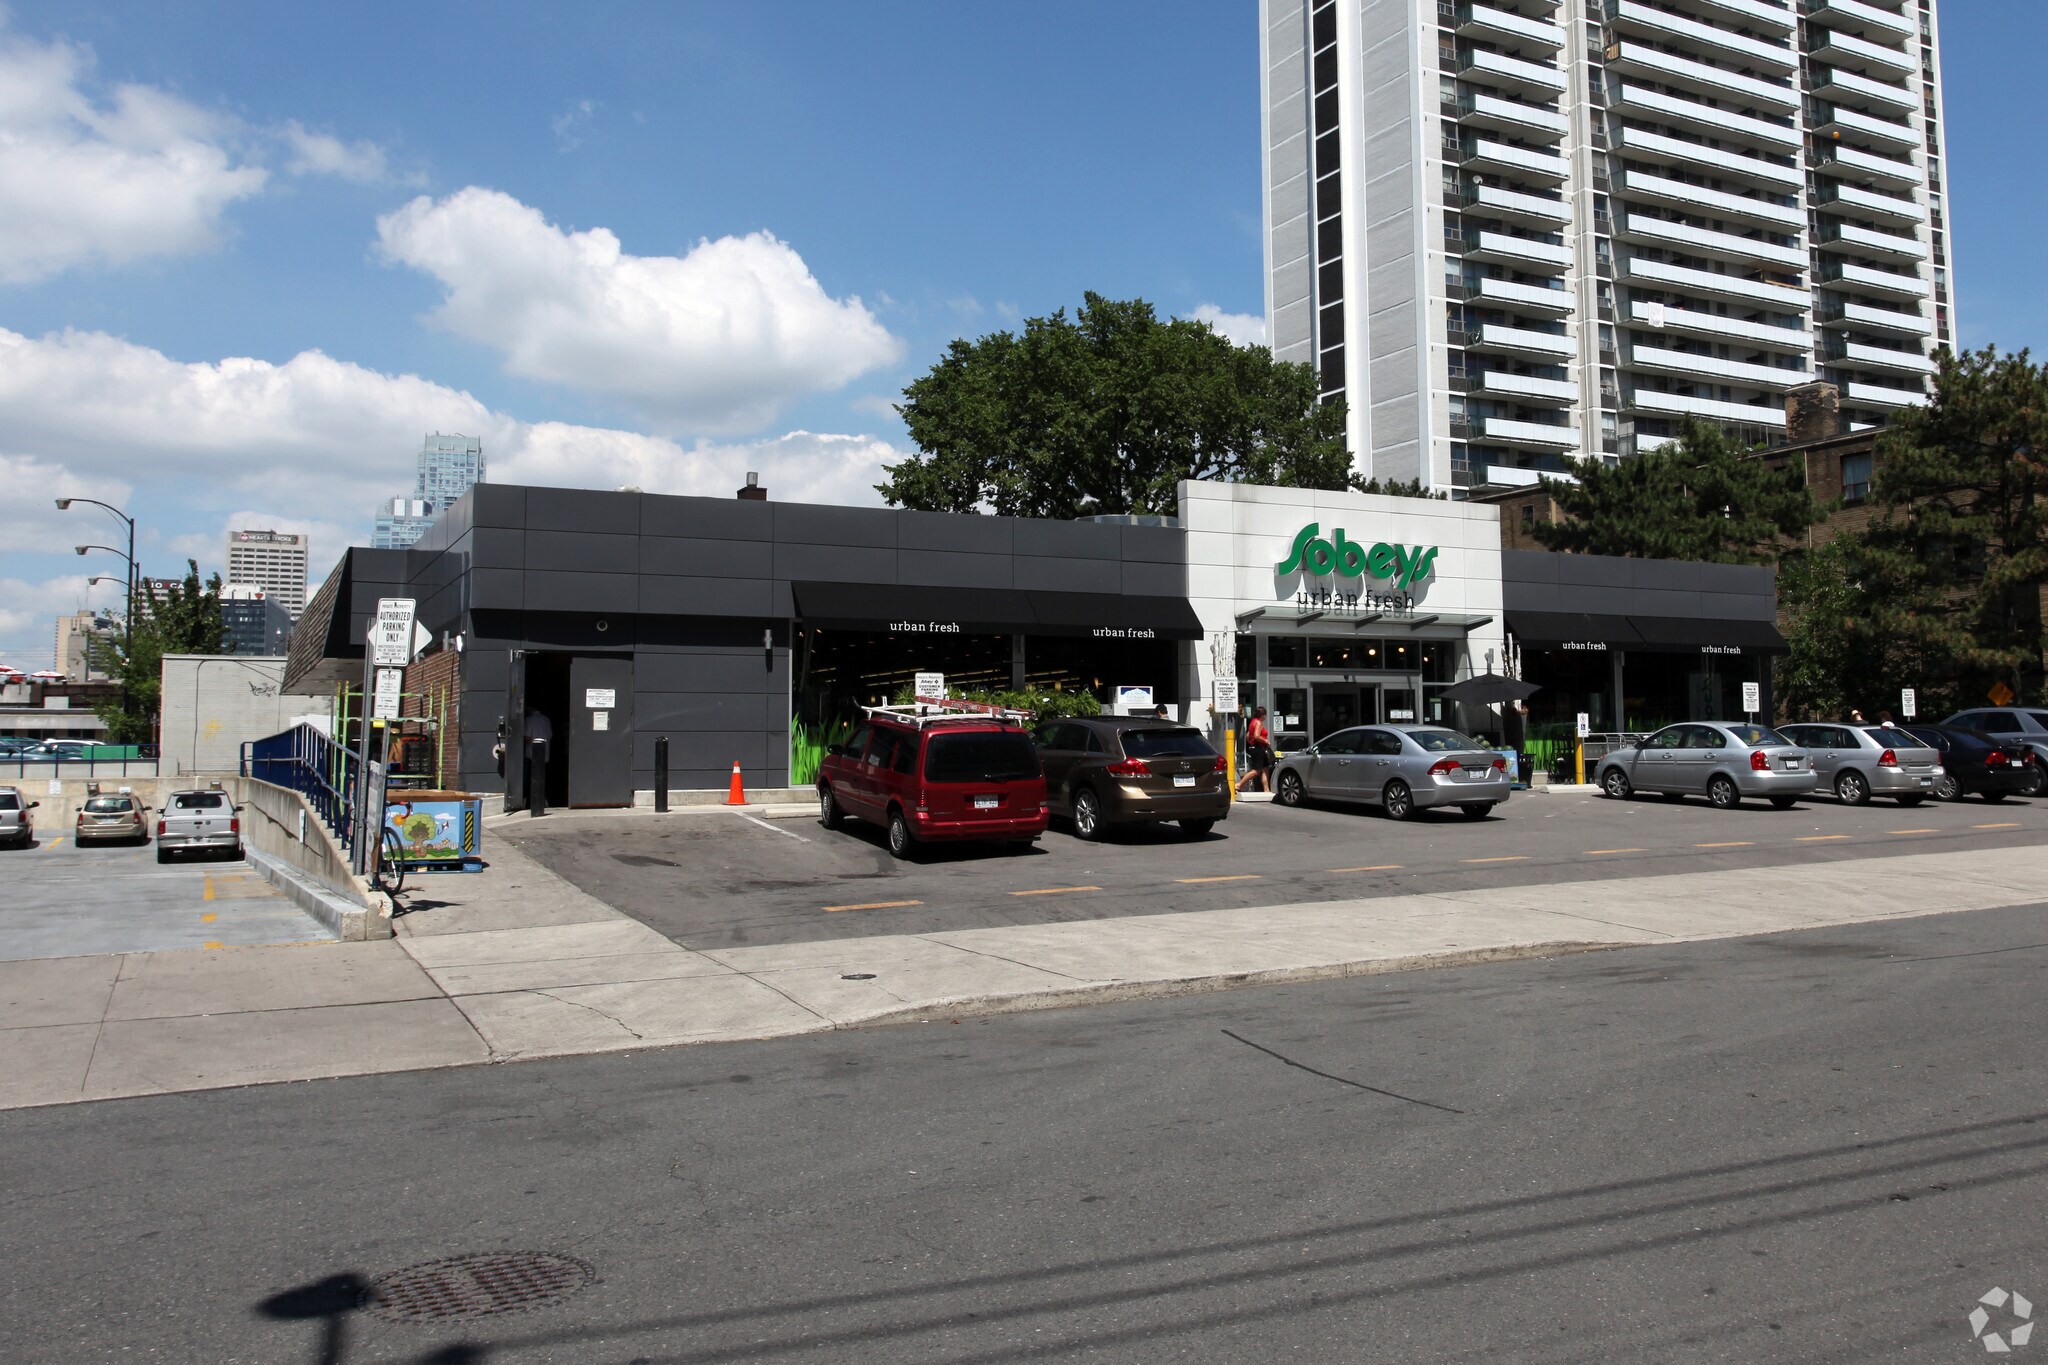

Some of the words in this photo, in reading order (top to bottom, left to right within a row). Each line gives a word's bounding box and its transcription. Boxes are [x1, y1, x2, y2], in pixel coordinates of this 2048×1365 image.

[1275, 522, 1439, 590] Sobeys
[1297, 587, 1358, 606] urban
[1365, 589, 1415, 609] fresh
[380, 612, 410, 621] AUTHORIZED
[382, 622, 405, 631] PARKING
[890, 621, 925, 631] urban
[929, 622, 960, 632] fresh
[1093, 627, 1125, 637] urban
[1128, 628, 1155, 638] fresh
[386, 633, 399, 642] ONLY
[1562, 641, 1585, 649] urban
[1587, 641, 1606, 650] fresh
[1701, 645, 1722, 653] urban
[1723, 645, 1741, 654] fresh
